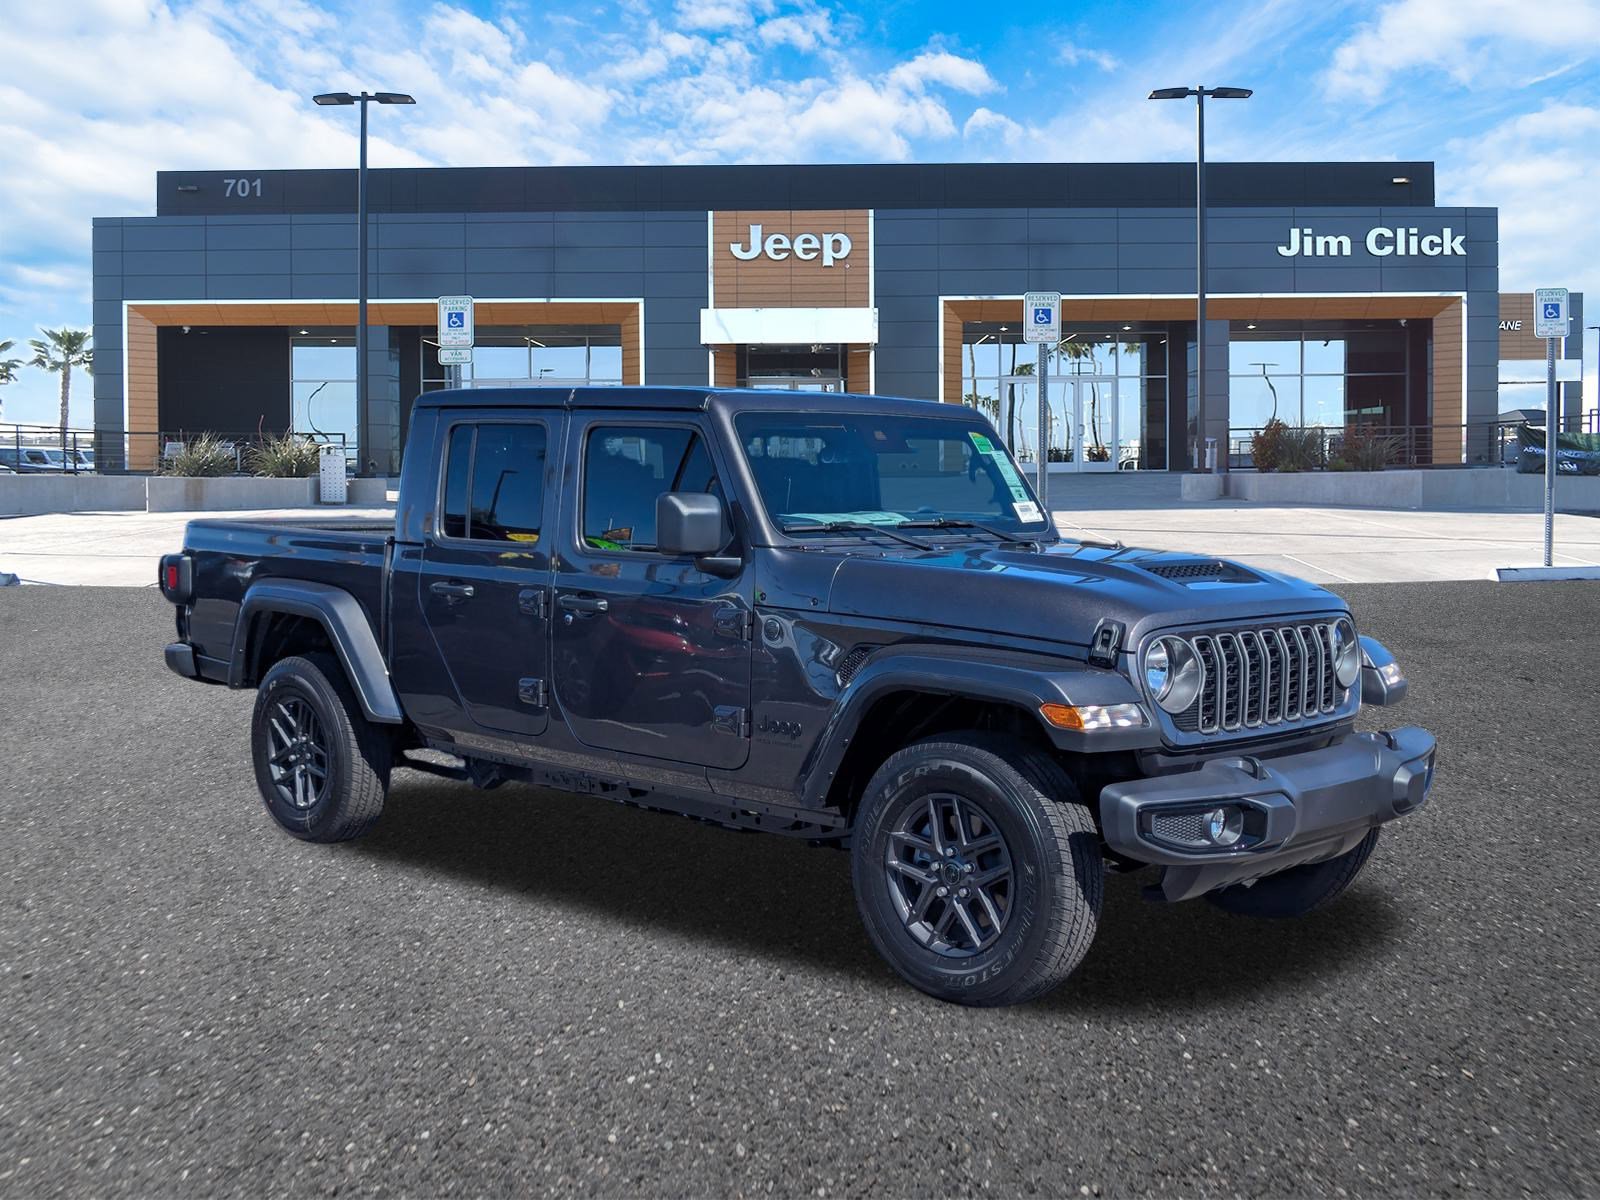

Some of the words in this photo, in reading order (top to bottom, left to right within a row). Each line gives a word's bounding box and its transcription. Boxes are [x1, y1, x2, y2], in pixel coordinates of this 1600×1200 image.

[223, 178, 262, 197] 701
[729, 223, 853, 268] Jeep
[1277, 227, 1352, 257] Jim
[1365, 226, 1467, 257] Click
